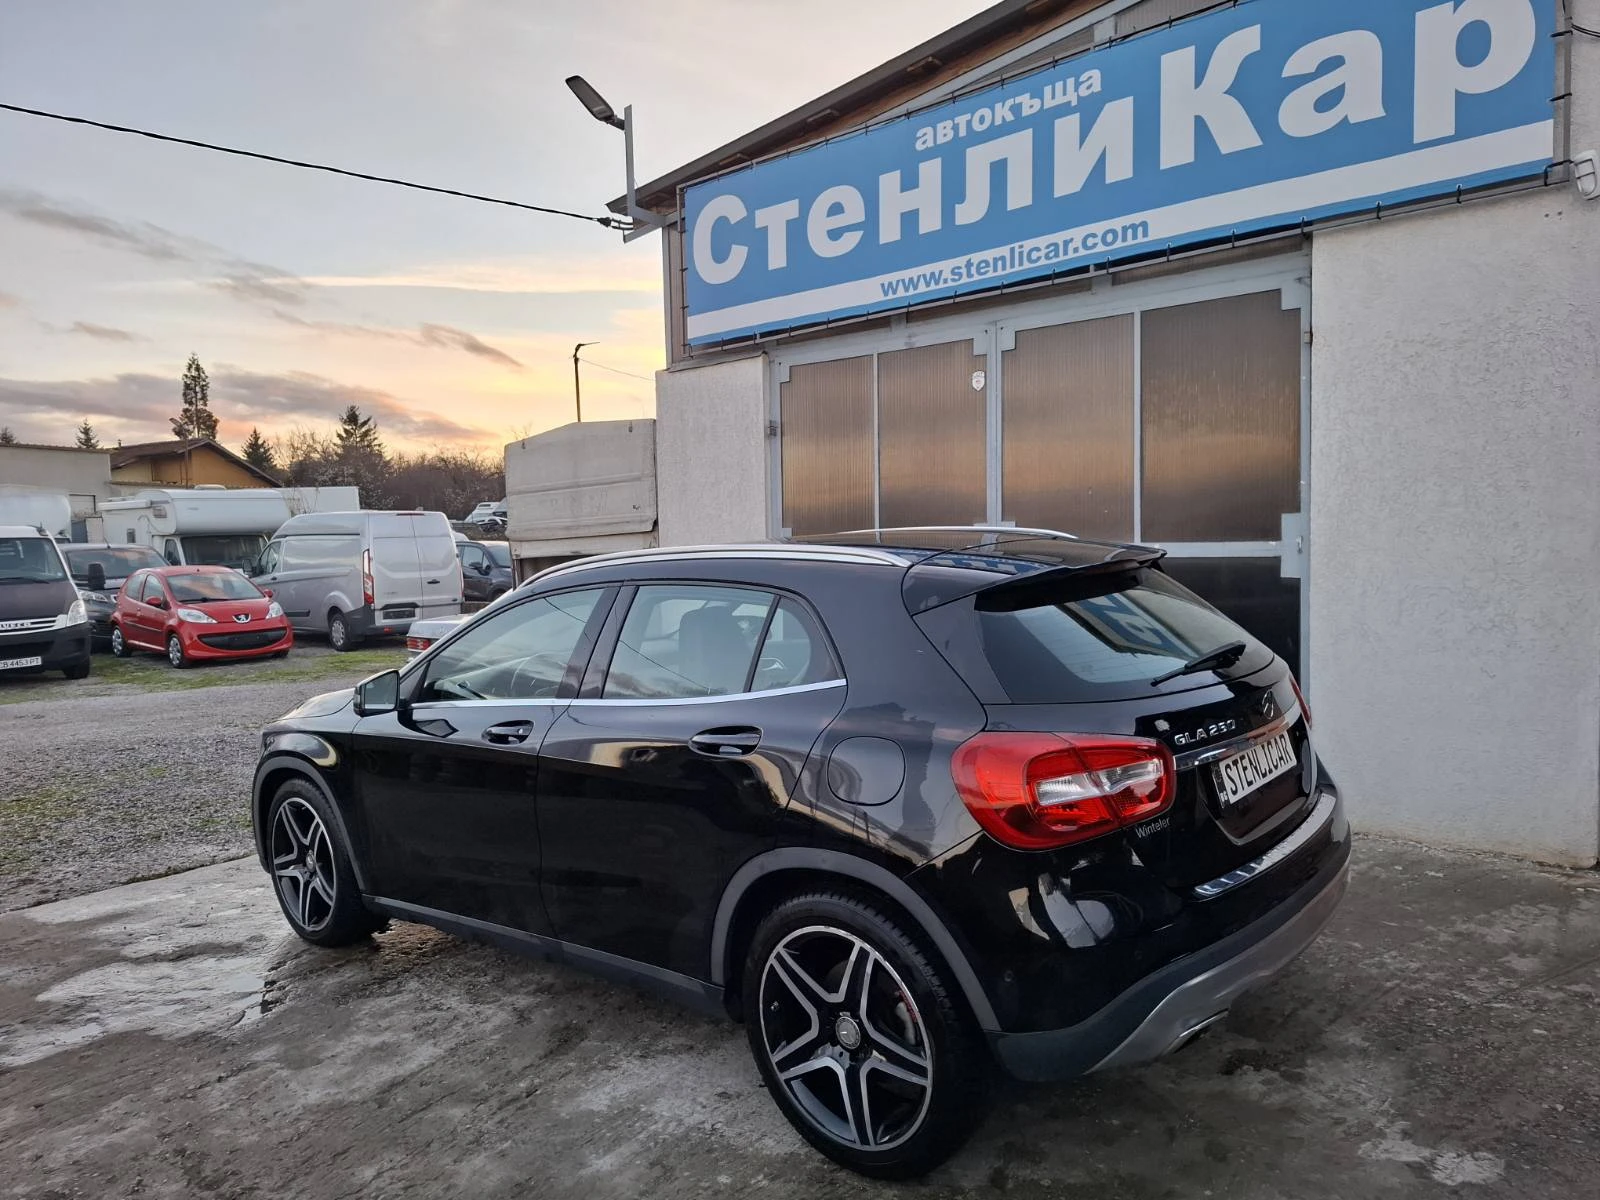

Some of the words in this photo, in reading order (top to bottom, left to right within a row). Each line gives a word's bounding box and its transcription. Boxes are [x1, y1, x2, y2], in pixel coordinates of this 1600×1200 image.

[692, 0, 1536, 284] СтенлиКар
[914, 68, 1103, 152] автокъща
[880, 220, 1150, 299] www.stenlicar.com
[1174, 728, 1208, 746] GLA
[1208, 719, 1236, 737] 250
[1224, 733, 1293, 796] STENLICAR
[1135, 817, 1171, 839] Winteler
